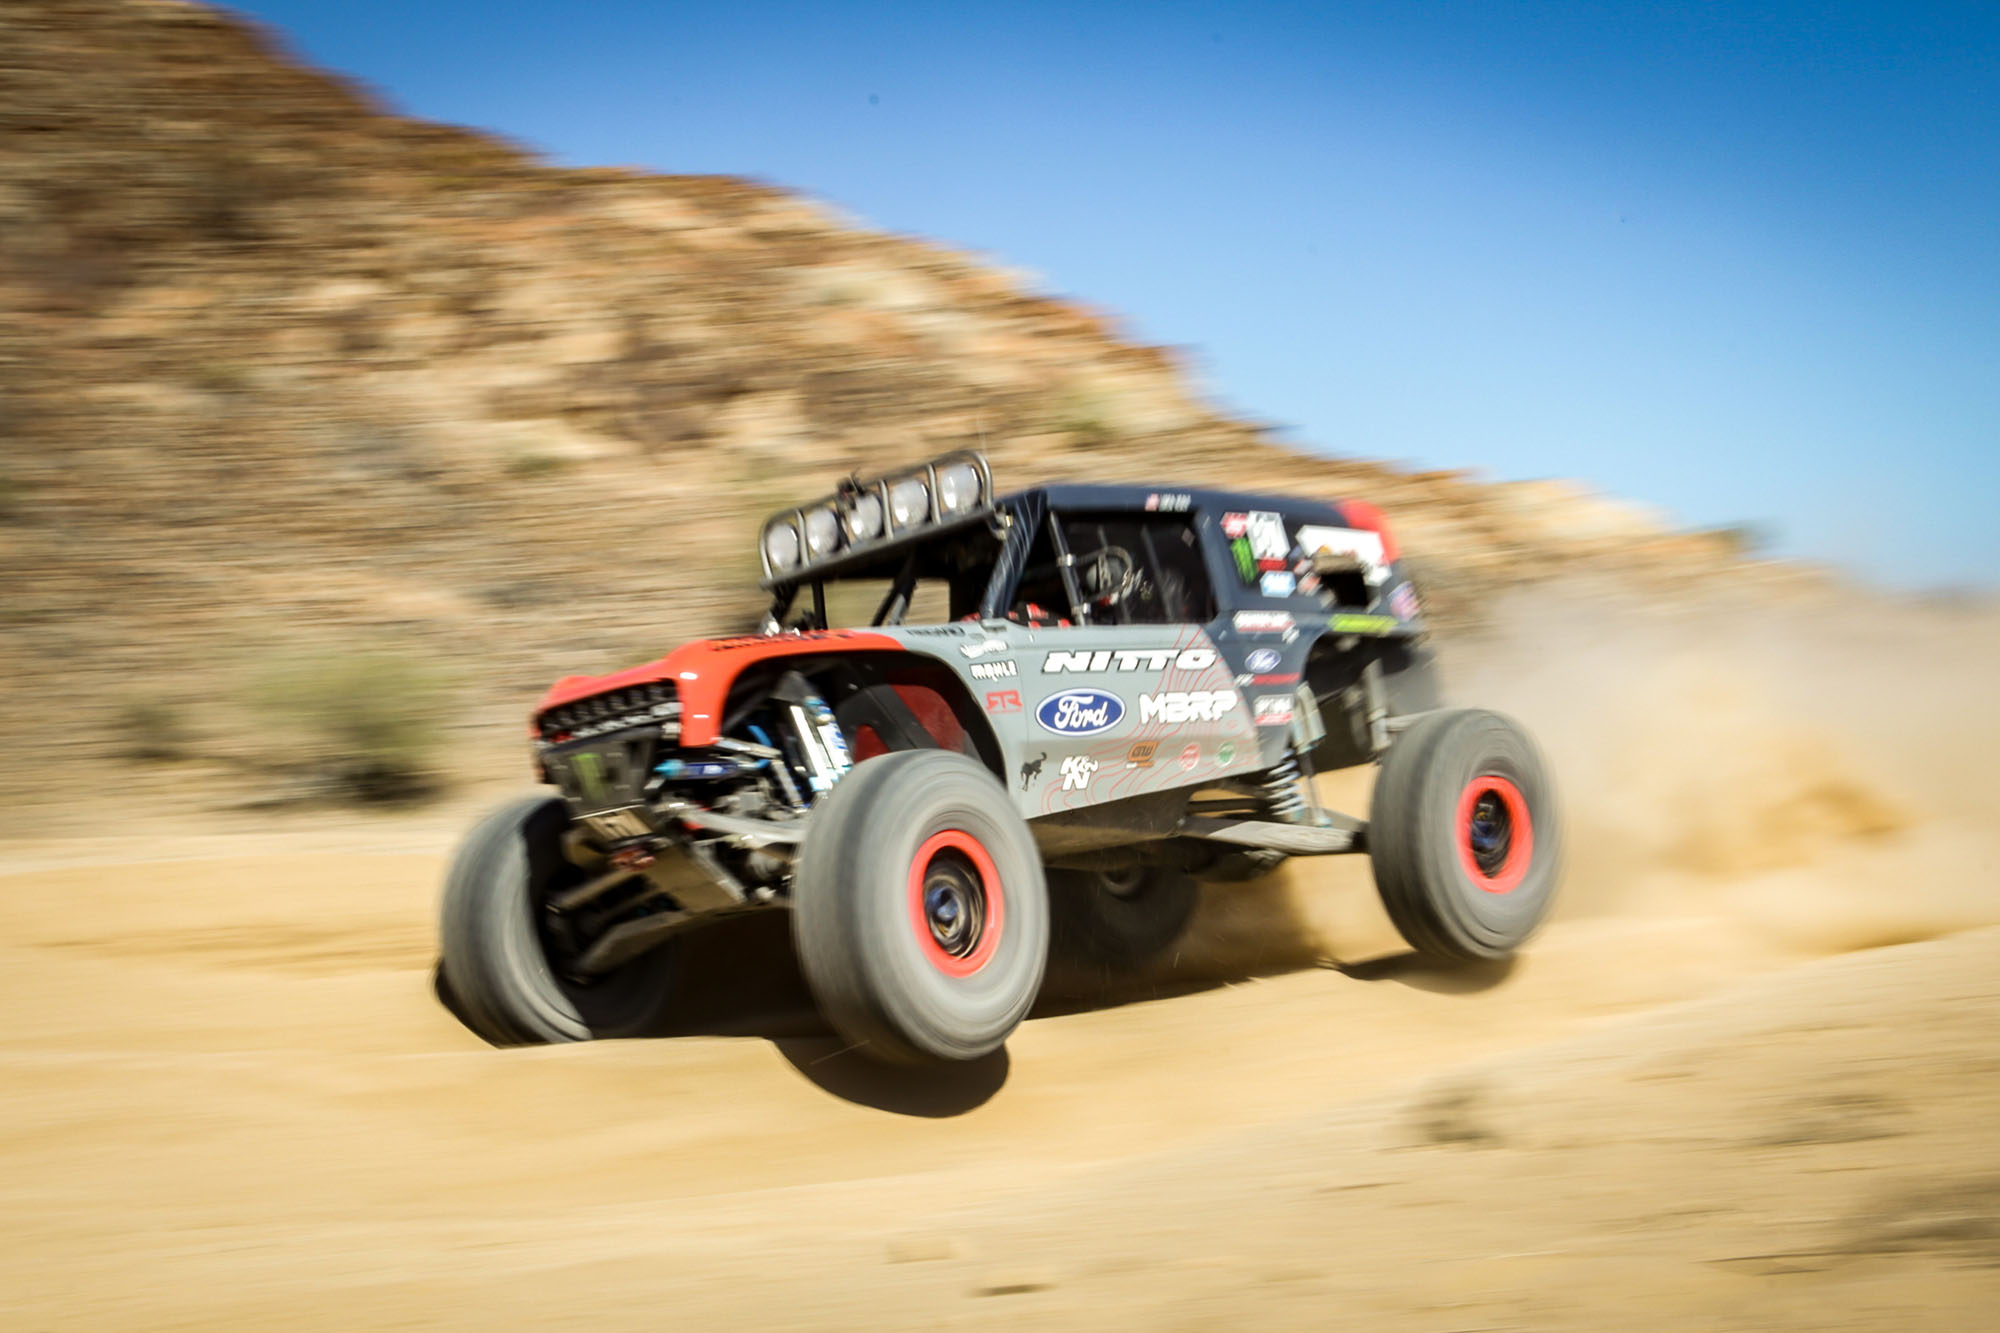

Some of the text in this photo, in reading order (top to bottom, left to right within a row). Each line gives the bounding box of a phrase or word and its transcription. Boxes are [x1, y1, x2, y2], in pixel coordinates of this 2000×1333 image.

[1042, 649, 1217, 673] NITTO
[1054, 694, 1109, 729] Ford
[1139, 690, 1239, 725] MBRP
